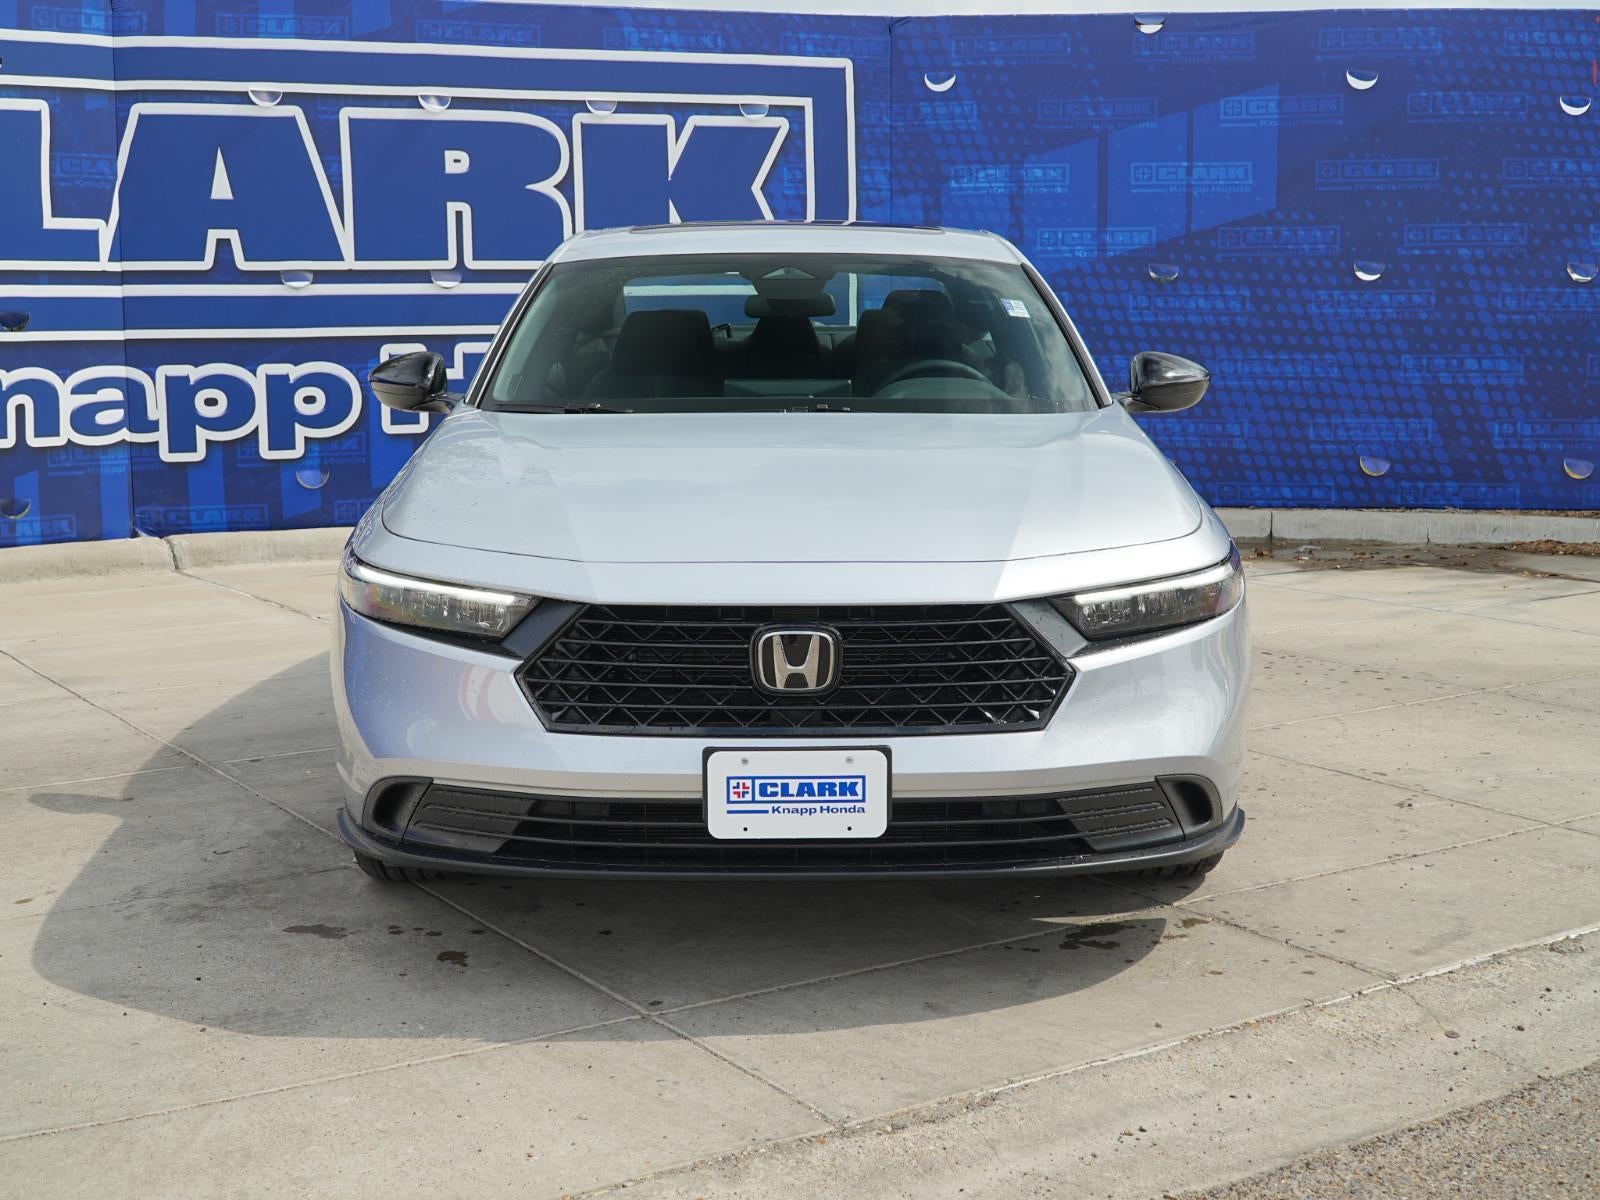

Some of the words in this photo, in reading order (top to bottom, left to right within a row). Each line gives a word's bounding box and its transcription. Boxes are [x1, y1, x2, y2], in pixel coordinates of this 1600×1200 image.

[1159, 166, 1247, 180] CLARK
[758, 781, 859, 798] CLARK
[771, 806, 817, 816] Knapp
[820, 805, 866, 814] Honda
